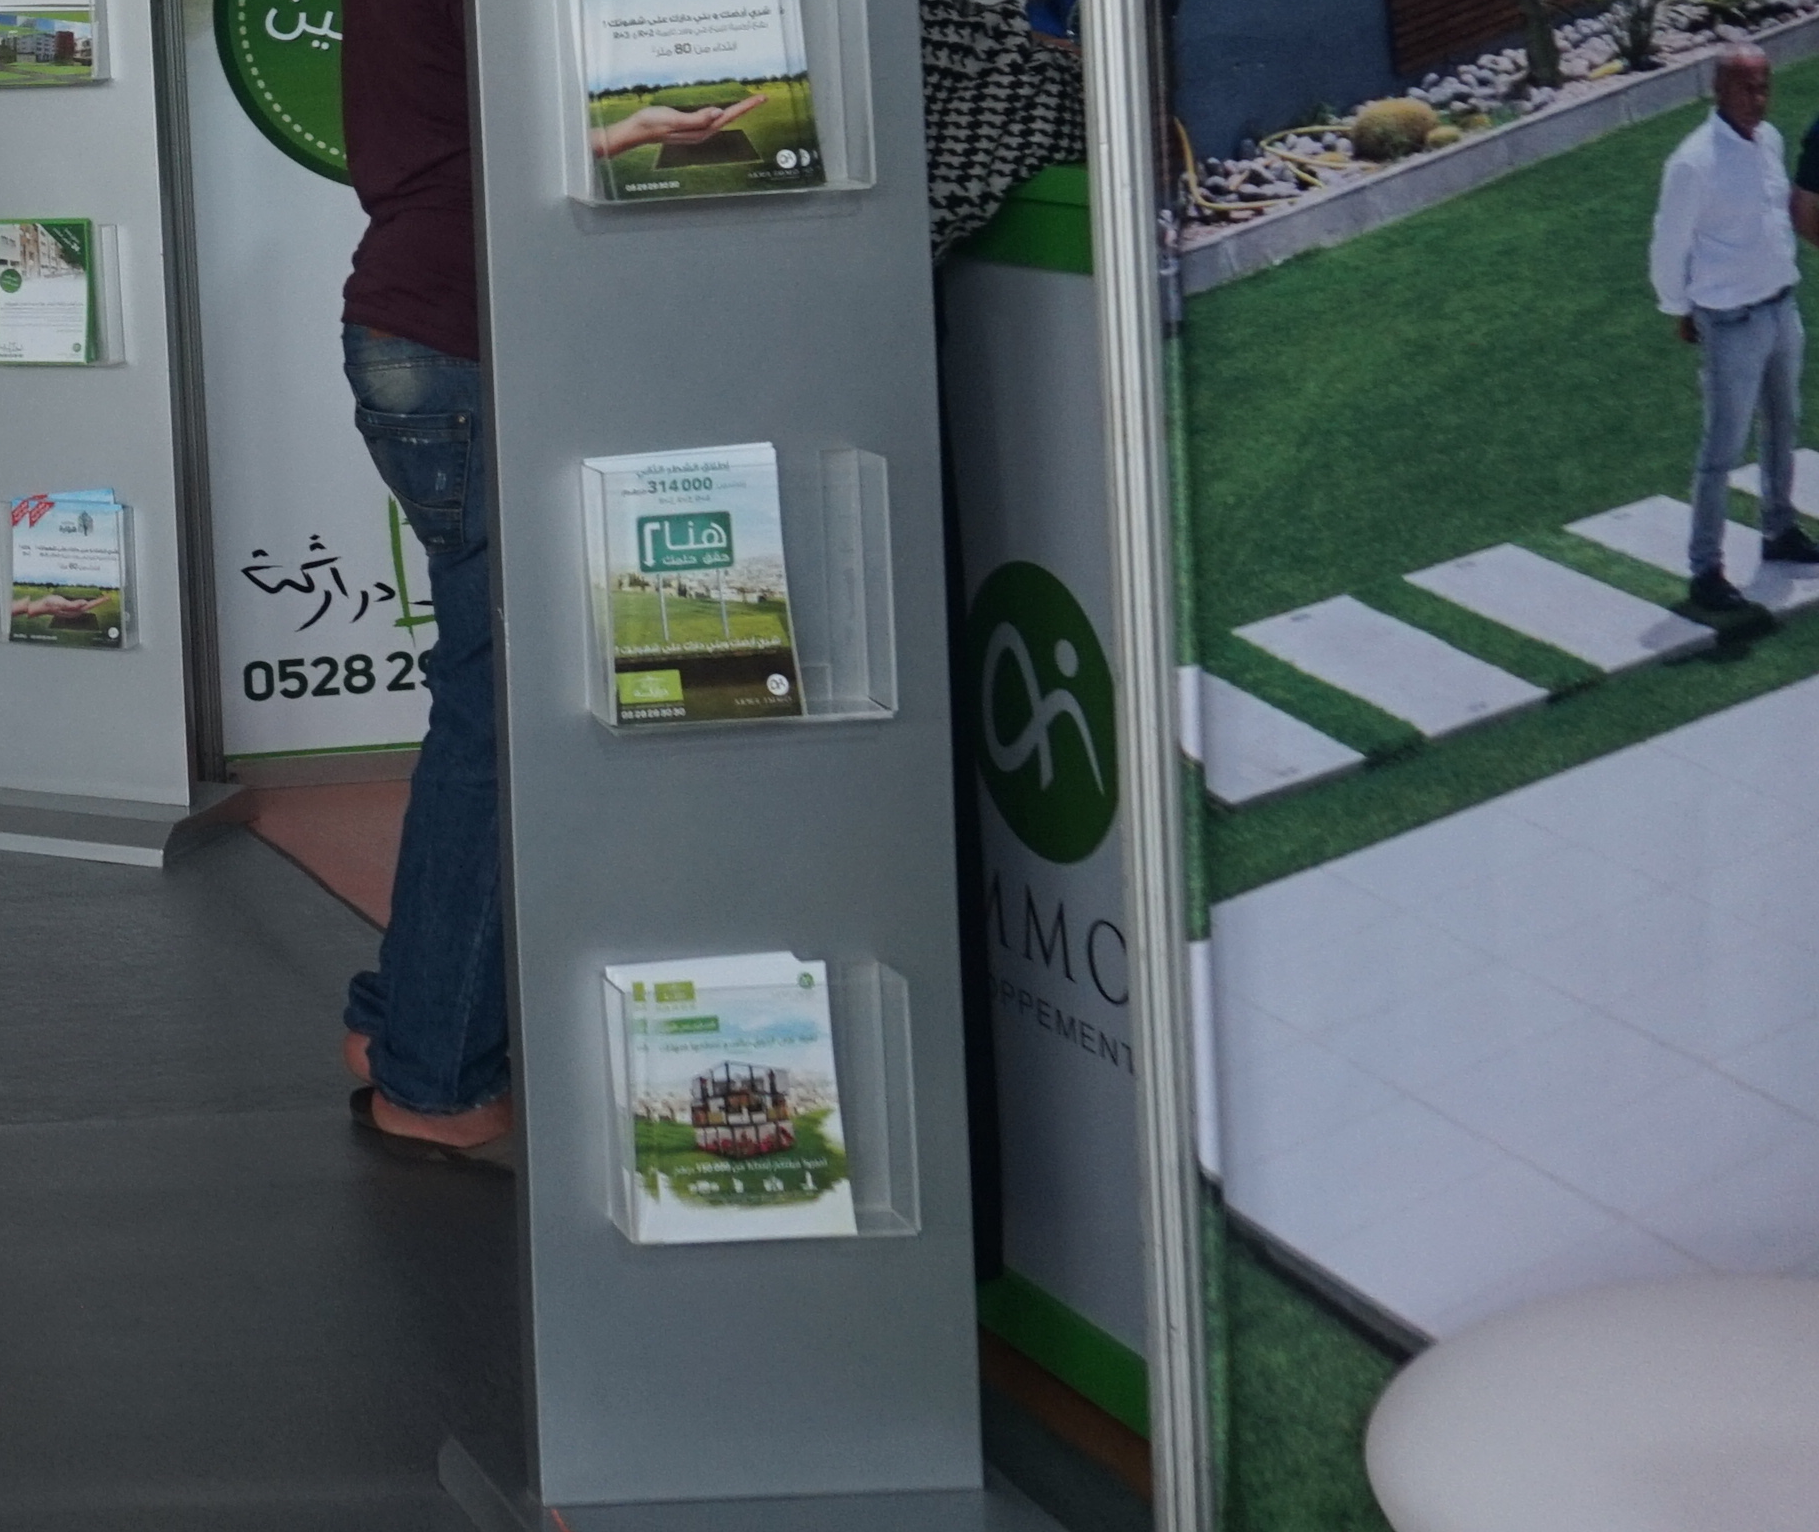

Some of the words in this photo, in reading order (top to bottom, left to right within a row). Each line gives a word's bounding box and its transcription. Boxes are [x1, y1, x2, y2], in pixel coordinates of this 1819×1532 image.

[674, 43, 692, 55] 80
[243, 653, 376, 702] 0528
[987, 873, 1129, 1006] MO
